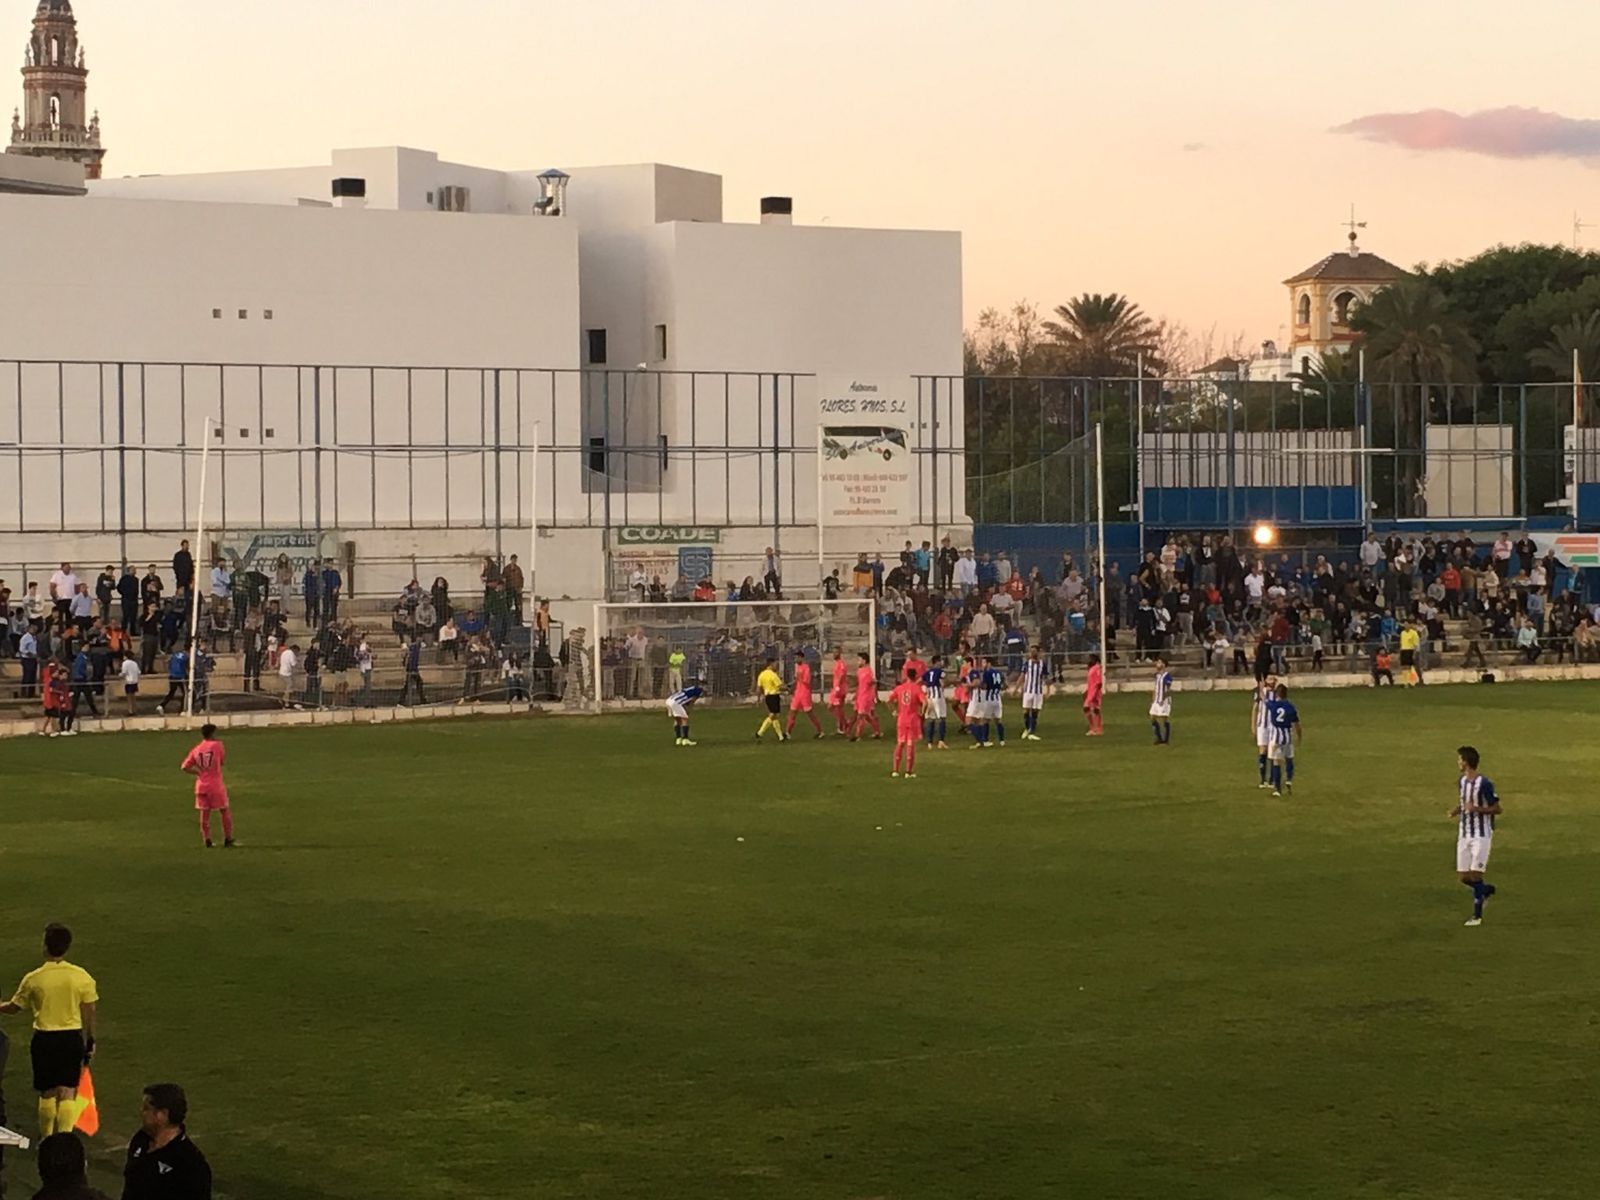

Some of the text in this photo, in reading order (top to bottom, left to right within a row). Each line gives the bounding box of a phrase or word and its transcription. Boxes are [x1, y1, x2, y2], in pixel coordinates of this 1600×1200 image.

[621, 526, 716, 541] COADE
[1276, 706, 1285, 722] 2
[198, 751, 214, 769] 17
